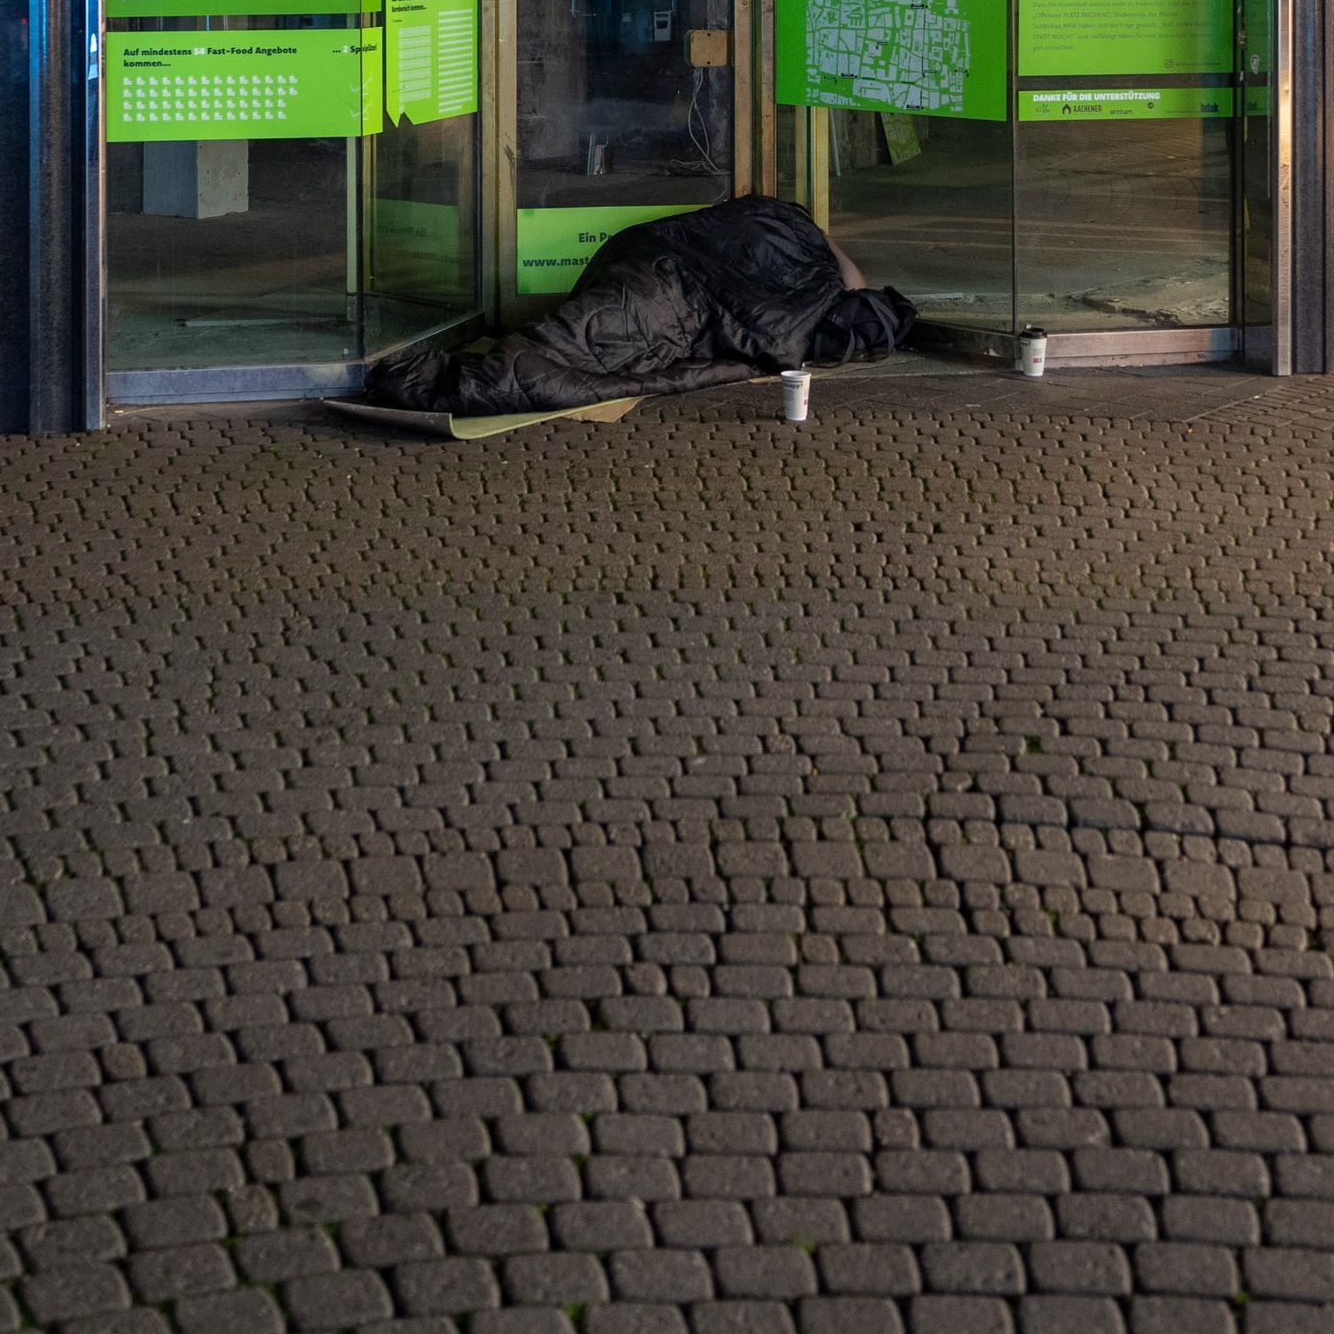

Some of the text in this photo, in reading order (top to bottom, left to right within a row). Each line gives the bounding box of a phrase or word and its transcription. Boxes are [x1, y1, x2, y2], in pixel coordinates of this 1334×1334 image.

[123, 48, 139, 56] Auf
[141, 47, 192, 56] mindestens
[207, 46, 253, 56] Fast-Food
[255, 46, 297, 58] Angebote
[123, 59, 171, 68] kommen...
[1033, 90, 1161, 103] DANKE FÜR DIE UNTERSTÜTZUNG
[1073, 104, 1102, 114] AACHENER
[578, 232, 597, 243] Ein
